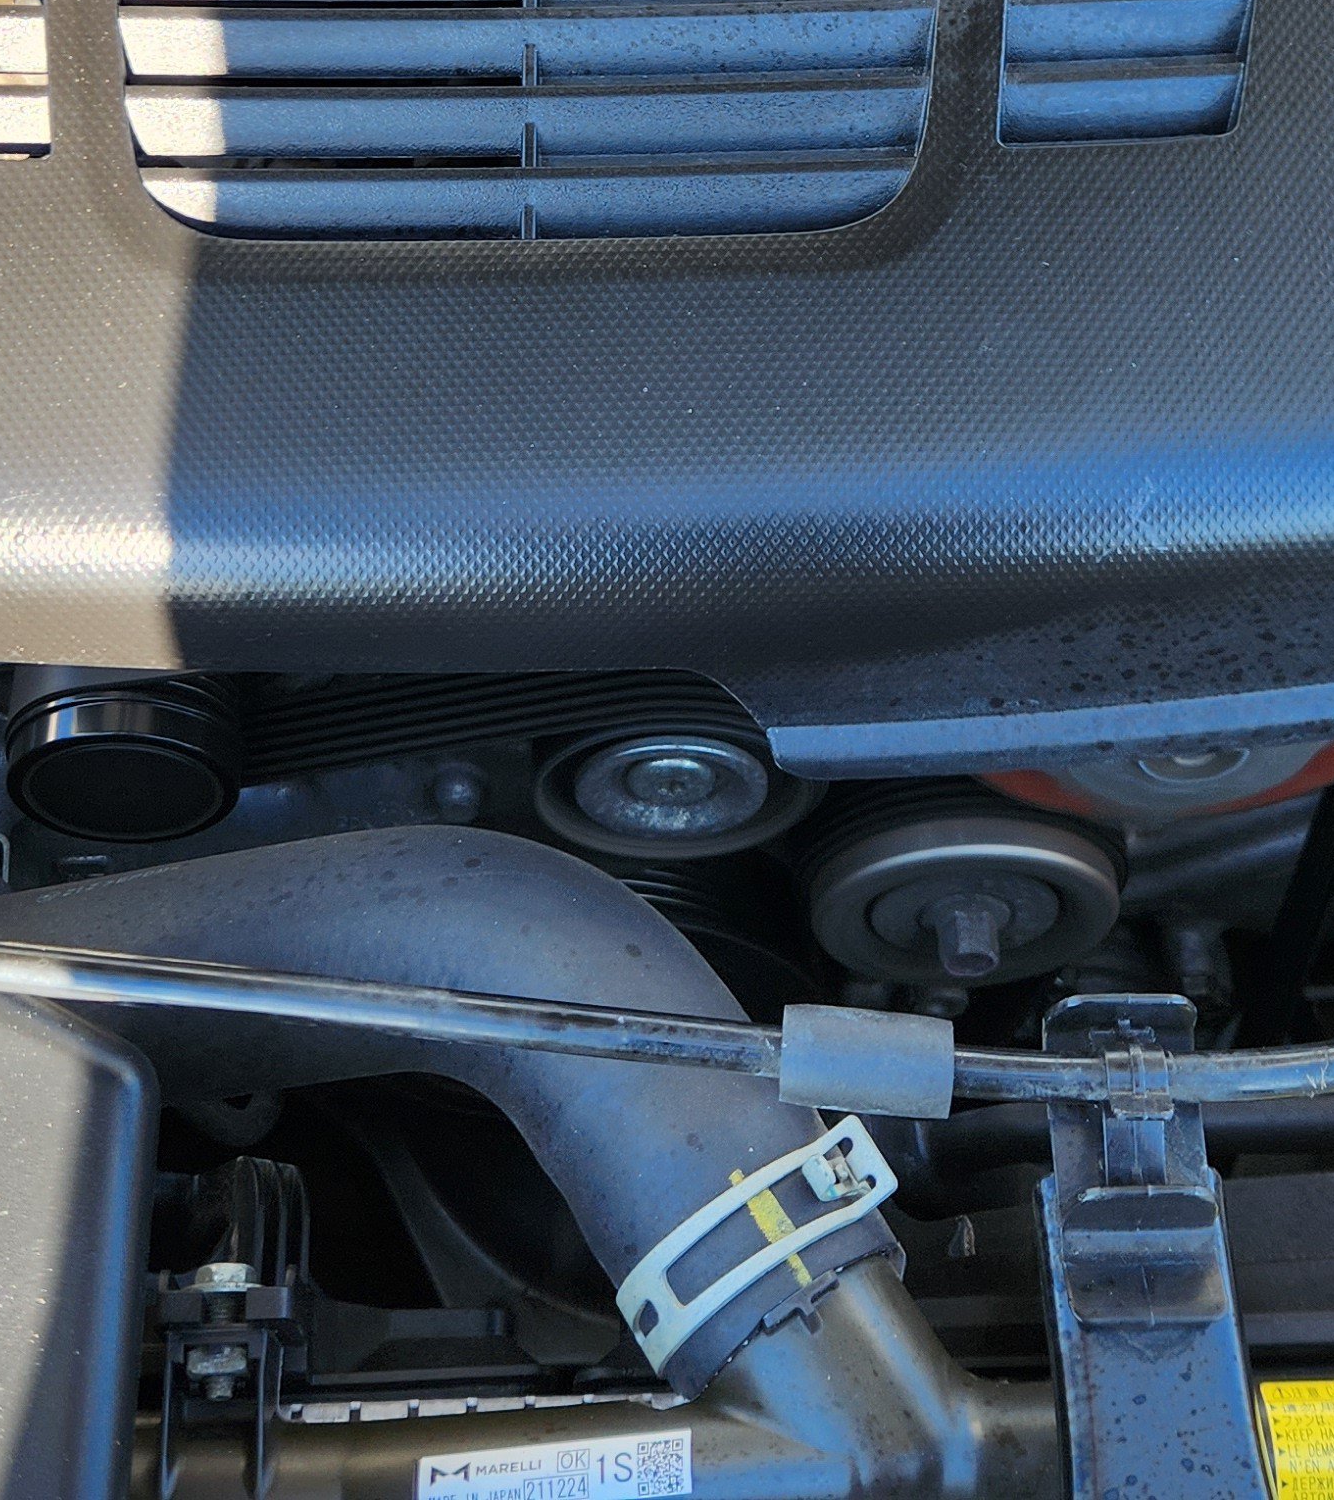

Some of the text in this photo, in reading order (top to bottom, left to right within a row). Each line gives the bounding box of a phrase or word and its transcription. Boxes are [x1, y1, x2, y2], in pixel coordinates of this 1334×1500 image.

[1285, 1427, 1313, 1441] KEEP
[1288, 1444, 1302, 1457] LE
[475, 1451, 633, 1484] MARELLI OK 1S
[1289, 1460, 1320, 1473] N'EN
[526, 1475, 588, 1500] 211224
